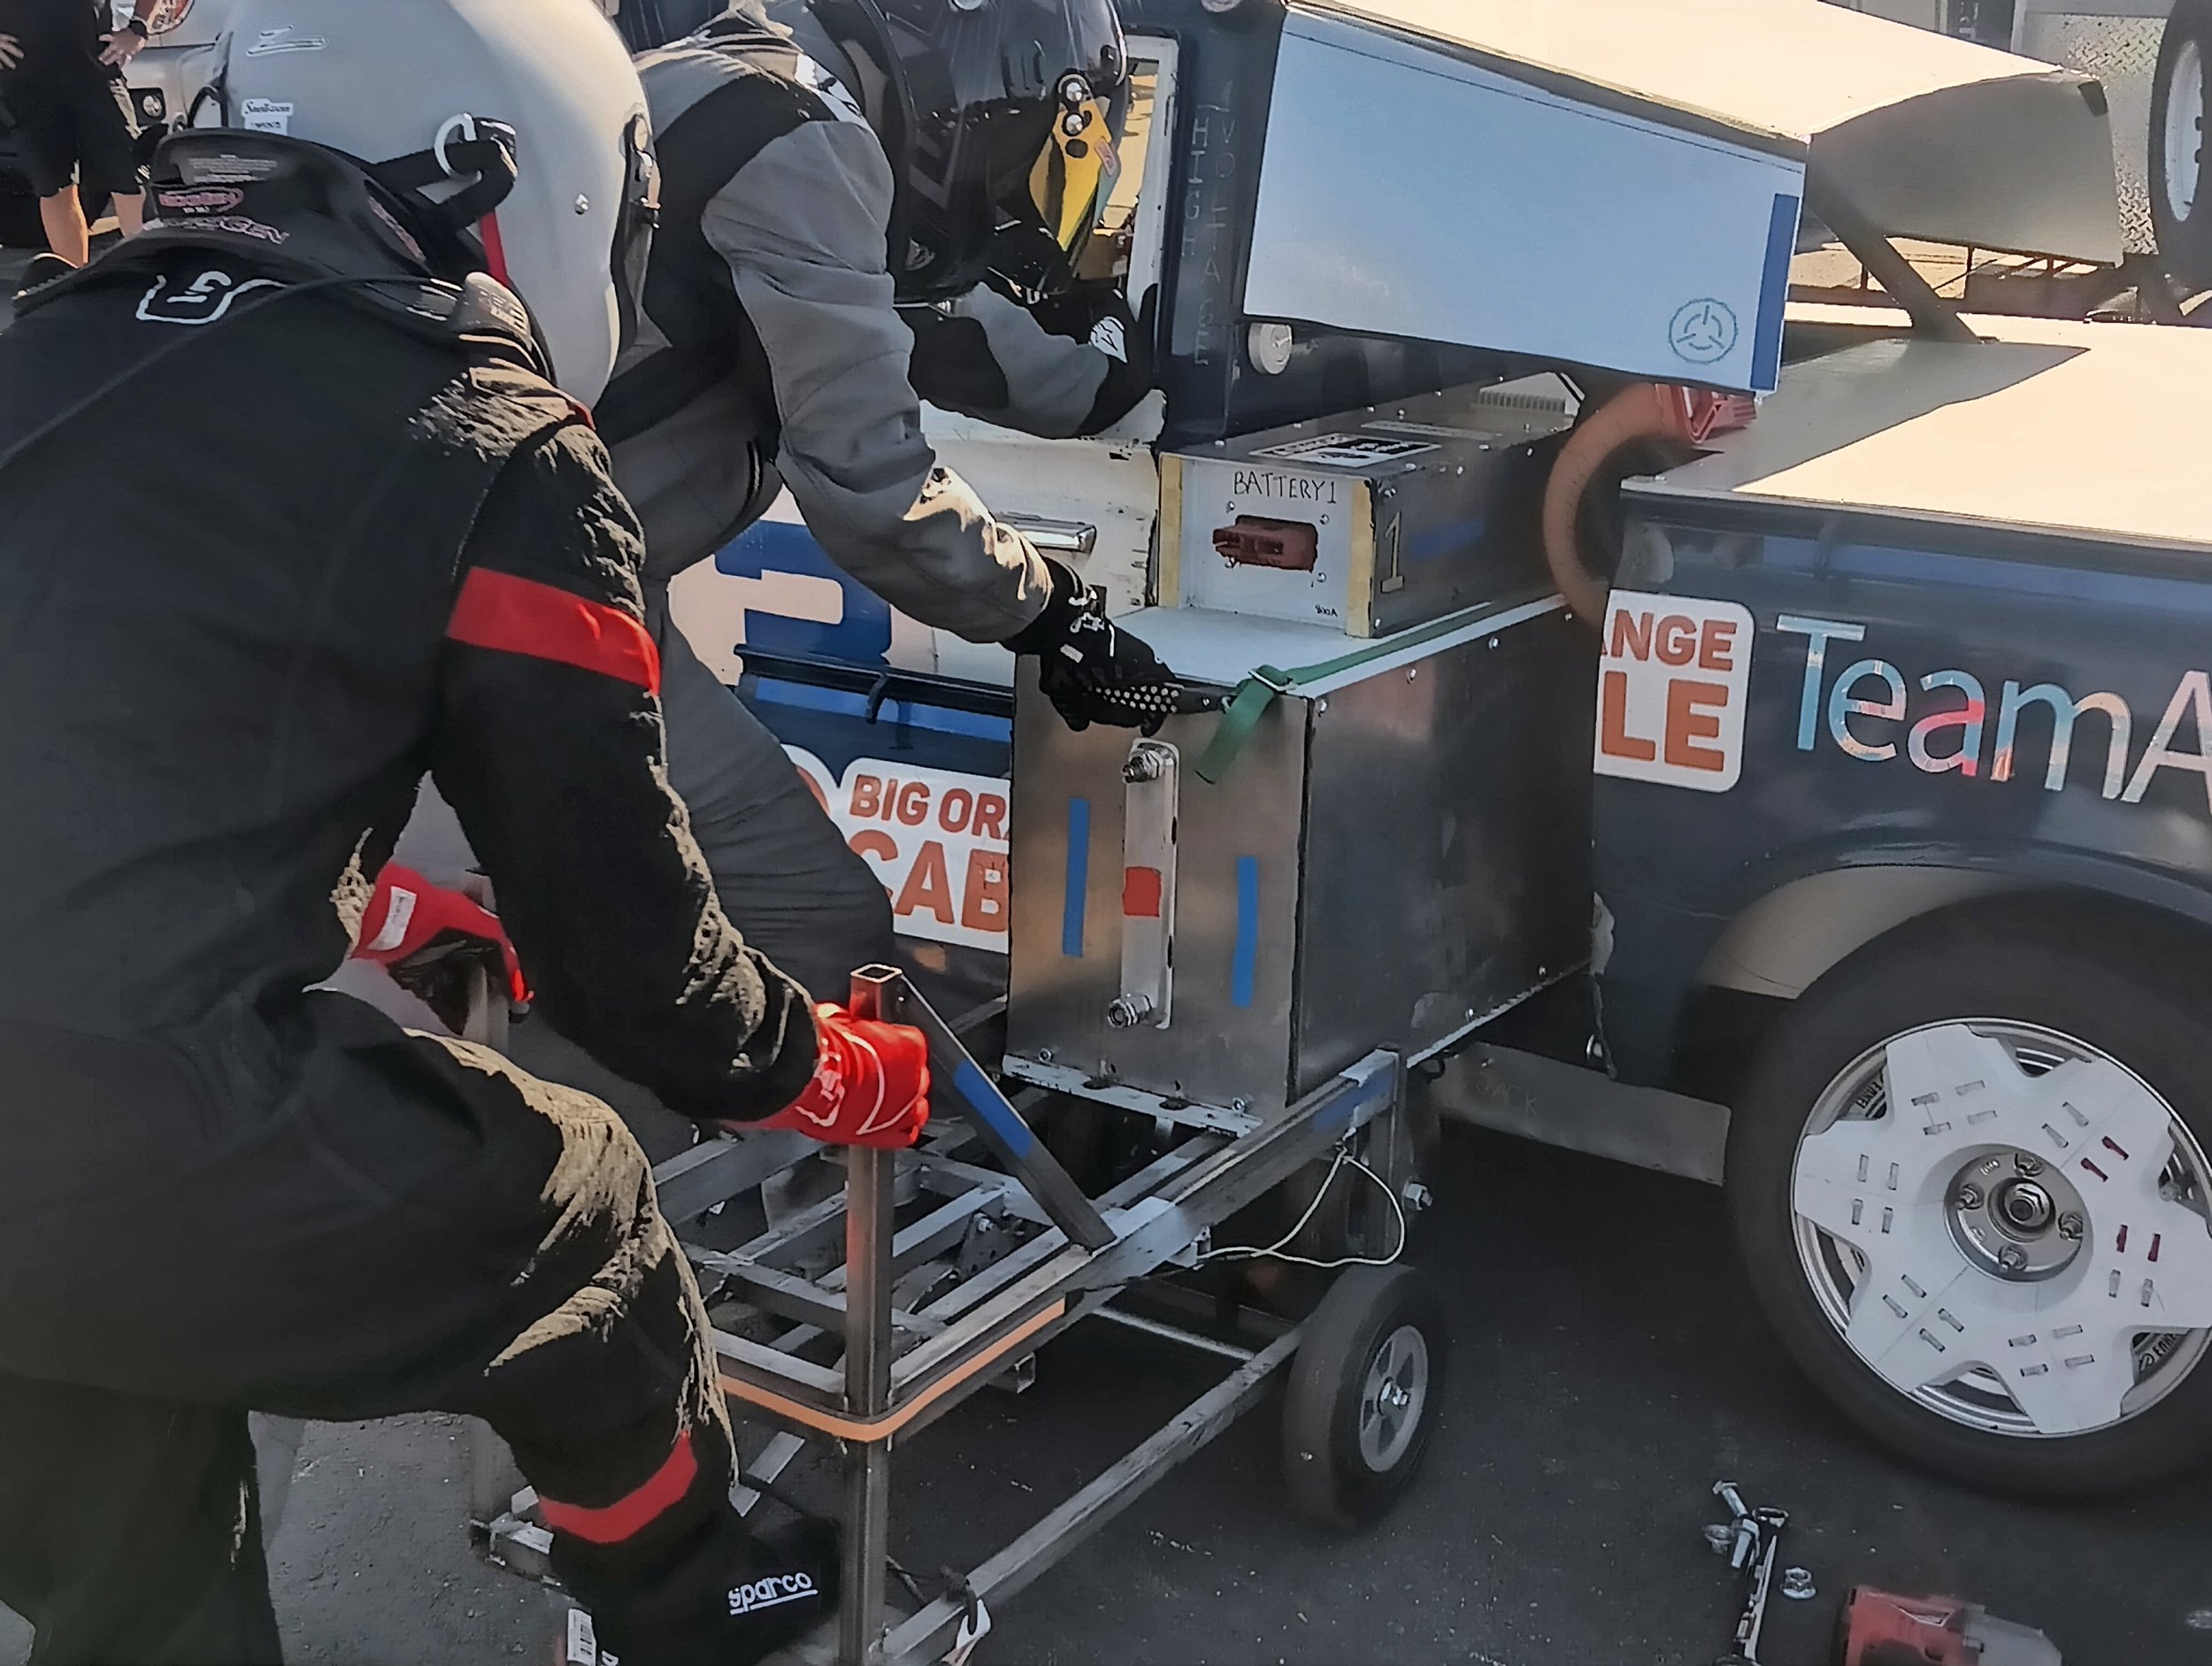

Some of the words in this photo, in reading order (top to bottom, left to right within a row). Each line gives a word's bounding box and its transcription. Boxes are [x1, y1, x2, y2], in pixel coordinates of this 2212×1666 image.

[1601, 608, 1738, 672] NGE
[1601, 670, 1729, 772] LE
[849, 773, 930, 825] BIG
[939, 787, 1009, 841] OR
[728, 1572, 814, 1613] sparco
